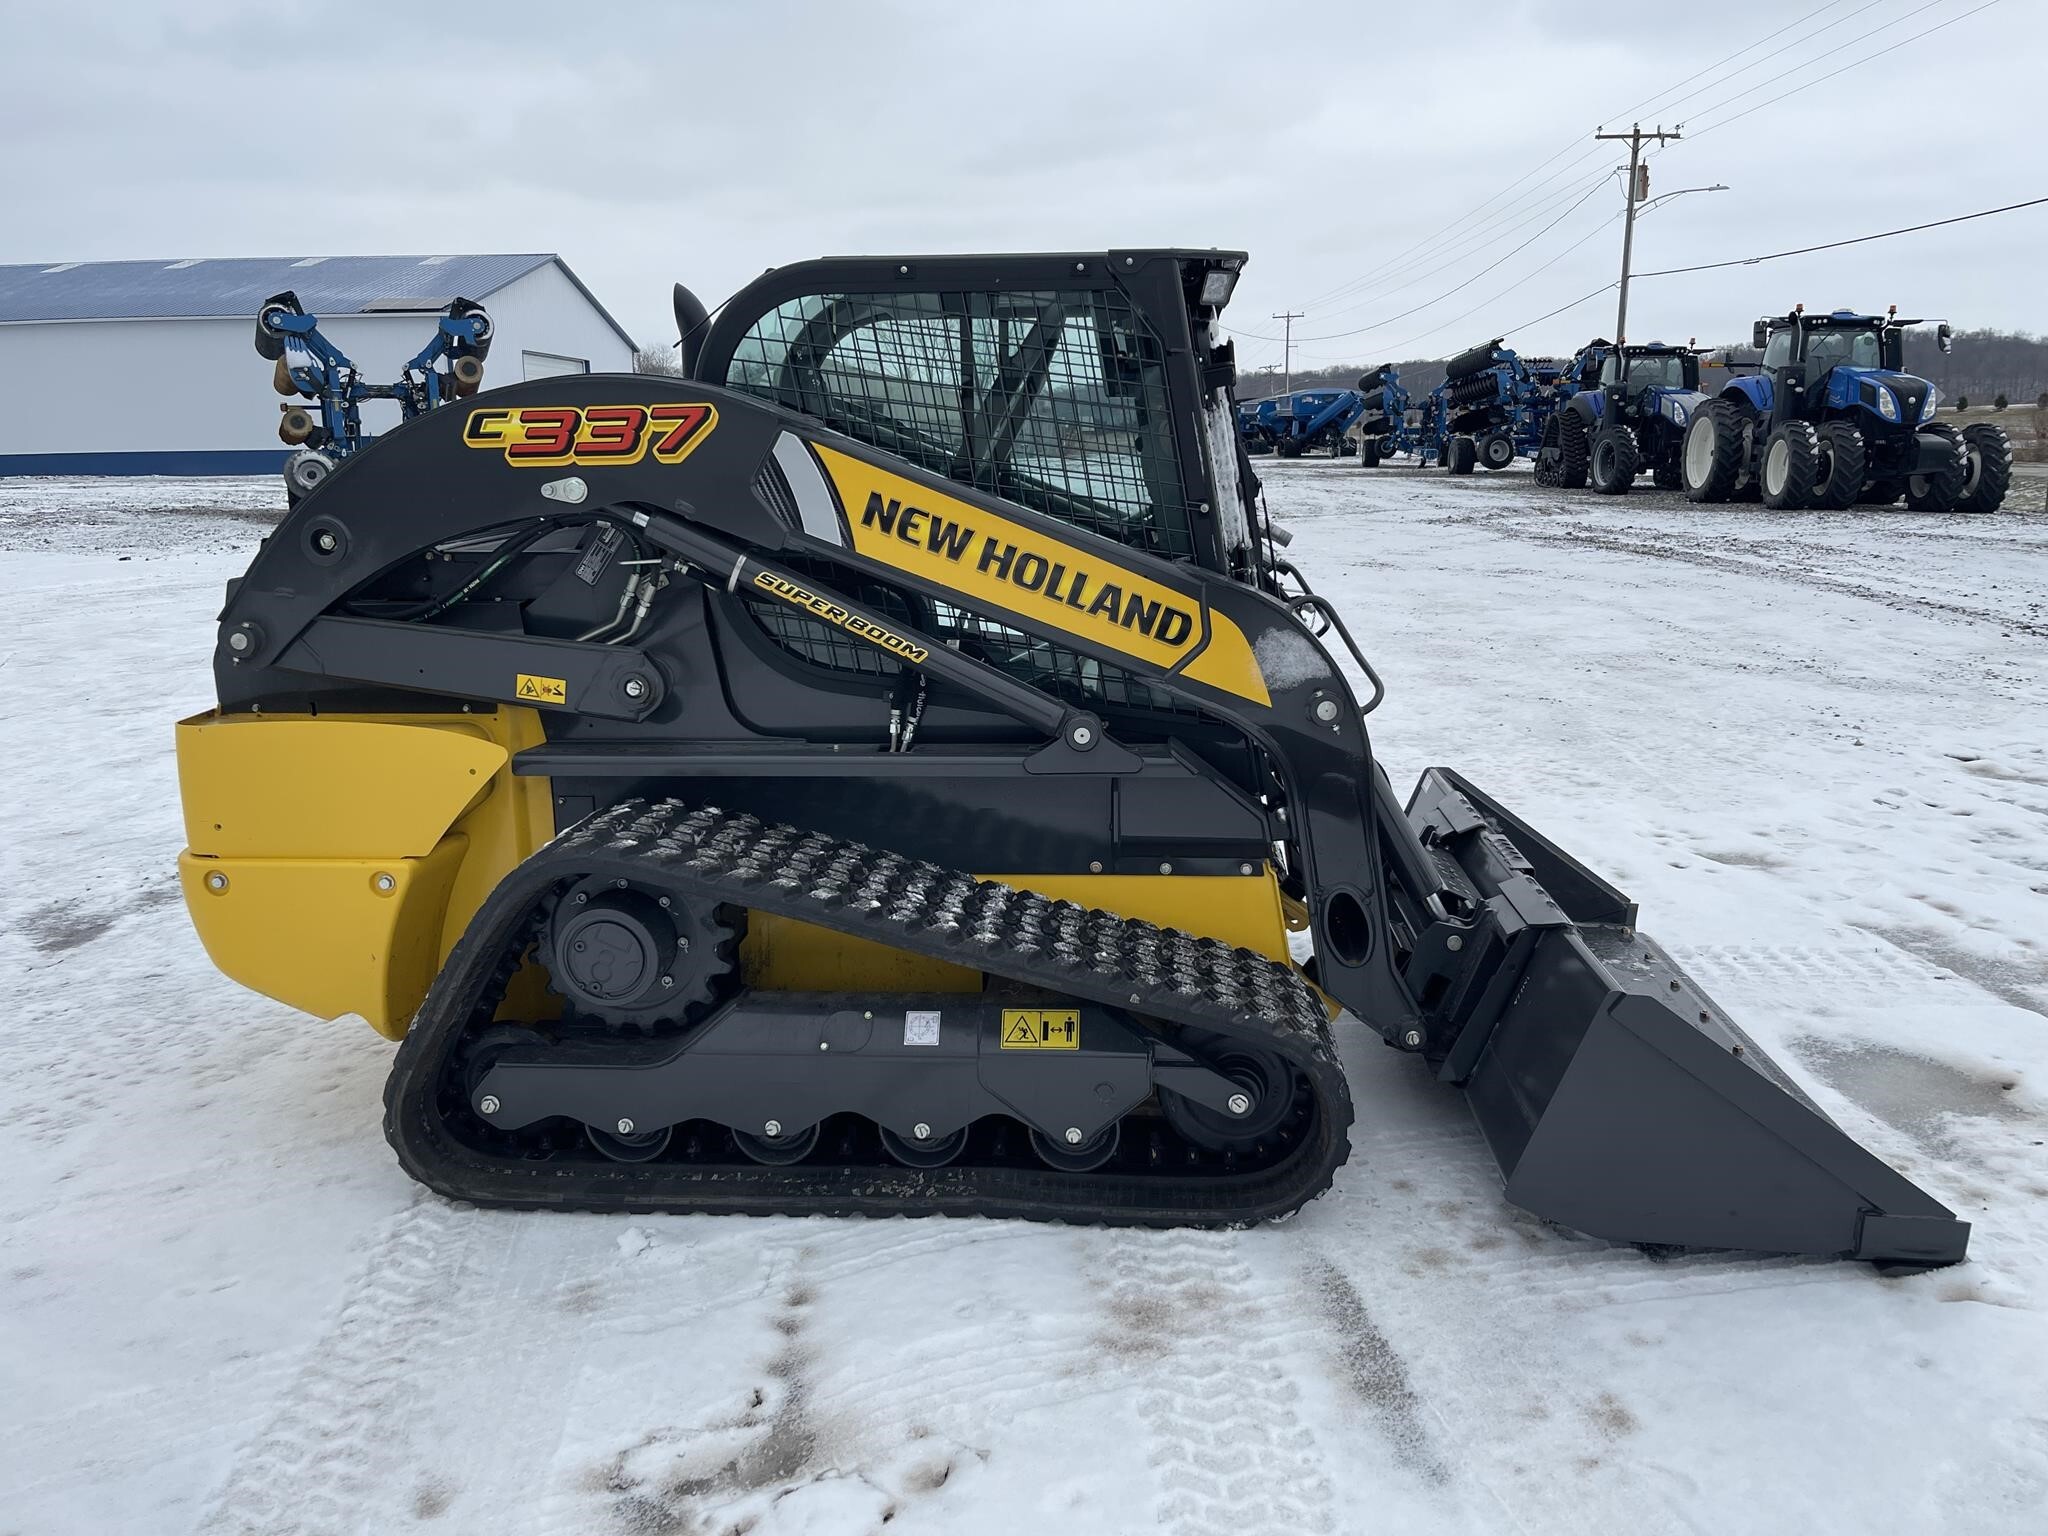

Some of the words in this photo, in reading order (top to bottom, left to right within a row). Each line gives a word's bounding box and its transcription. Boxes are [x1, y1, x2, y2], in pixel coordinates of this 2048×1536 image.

[465, 403, 717, 466] C337
[861, 491, 975, 565] NEW
[976, 537, 1193, 647] HOLLAND
[755, 571, 848, 625] SUPER
[846, 615, 928, 663] BOOM
